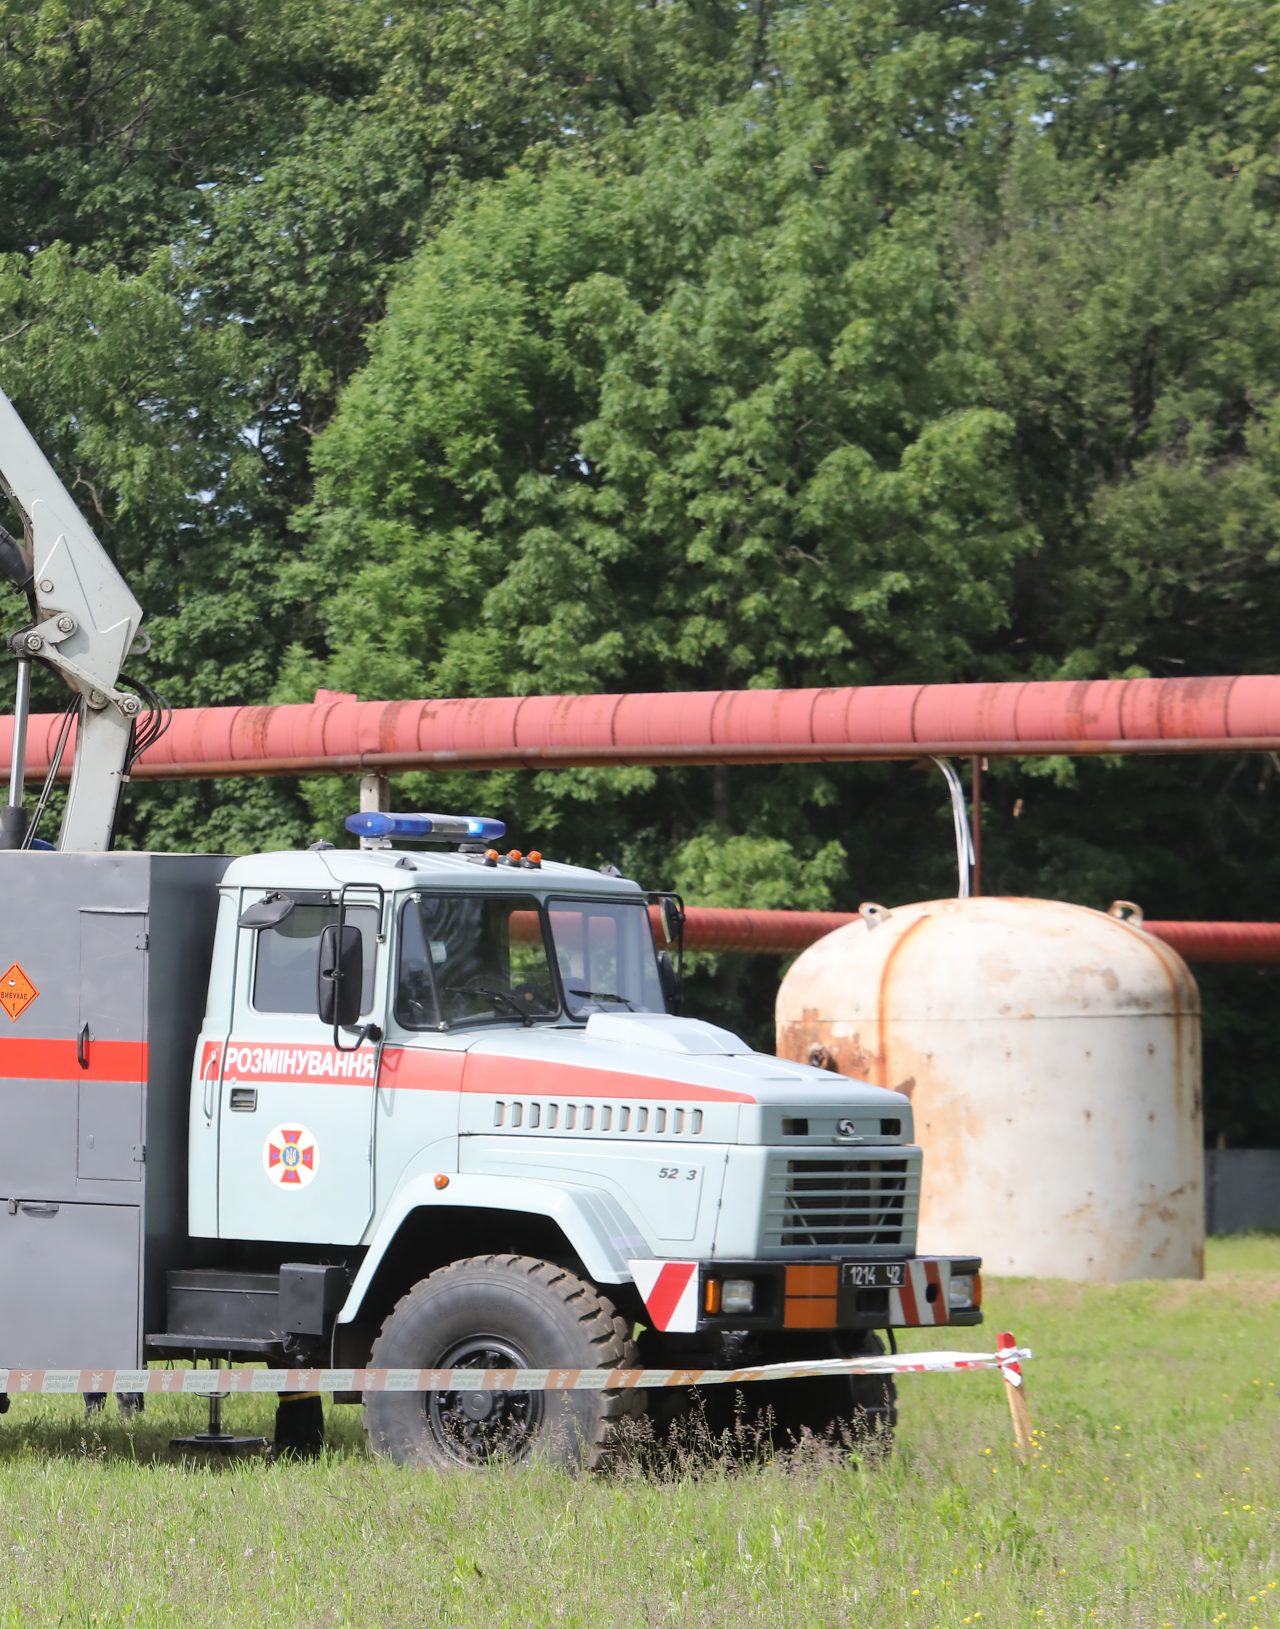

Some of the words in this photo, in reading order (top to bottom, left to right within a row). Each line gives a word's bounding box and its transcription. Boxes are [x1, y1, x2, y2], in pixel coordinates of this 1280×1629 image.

[0, 991, 28, 1000] ВИБУХАЄ
[224, 1048, 376, 1079] РОЗМІНУВАННЯ
[850, 1266, 876, 1285] 1214
